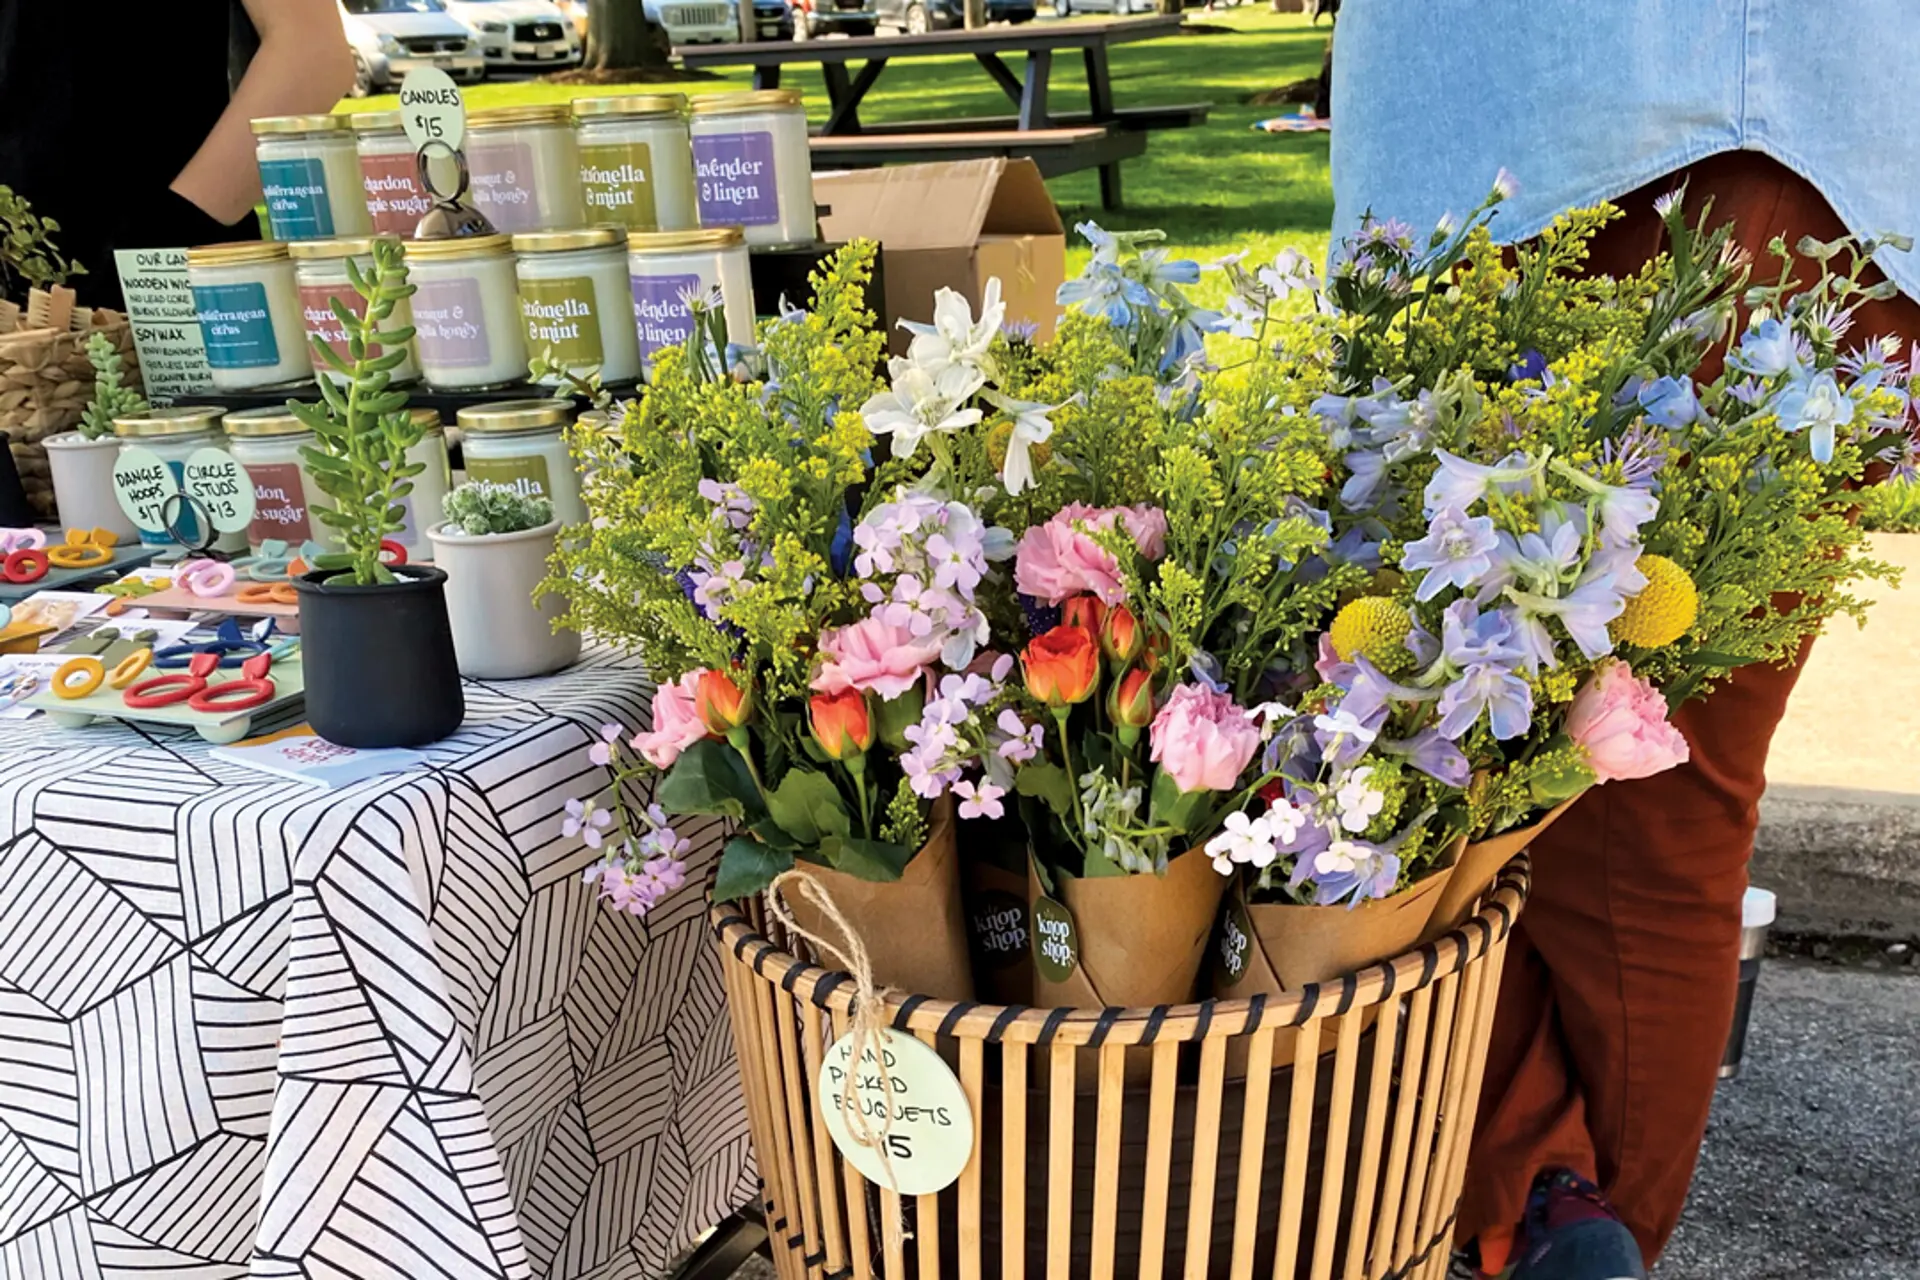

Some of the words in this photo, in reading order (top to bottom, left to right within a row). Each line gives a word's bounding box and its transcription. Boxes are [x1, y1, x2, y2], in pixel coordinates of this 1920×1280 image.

[401, 88, 460, 107] CANDLES
[416, 115, 443, 138] $15
[492, 187, 530, 205] honey
[594, 188, 634, 210] mint
[713, 182, 759, 205] linen
[391, 195, 432, 216] sugar
[136, 253, 162, 266] OUR
[123, 277, 168, 290] WOODEN
[171, 277, 192, 290] WIC
[158, 328, 186, 342] WAX
[439, 323, 480, 341] honey
[538, 323, 580, 345] mint
[645, 323, 687, 346] linen
[115, 465, 164, 488] DANGLE
[187, 462, 237, 479] CIRCLE
[128, 487, 164, 504] HOOPS
[193, 482, 239, 498] STUDS
[138, 504, 162, 525] $17
[208, 501, 236, 519] $13
[261, 505, 304, 525] sugar
[974, 907, 1022, 932] knop
[1036, 912, 1070, 944] knop
[983, 927, 1026, 951] shop
[1042, 936, 1070, 966] shop
